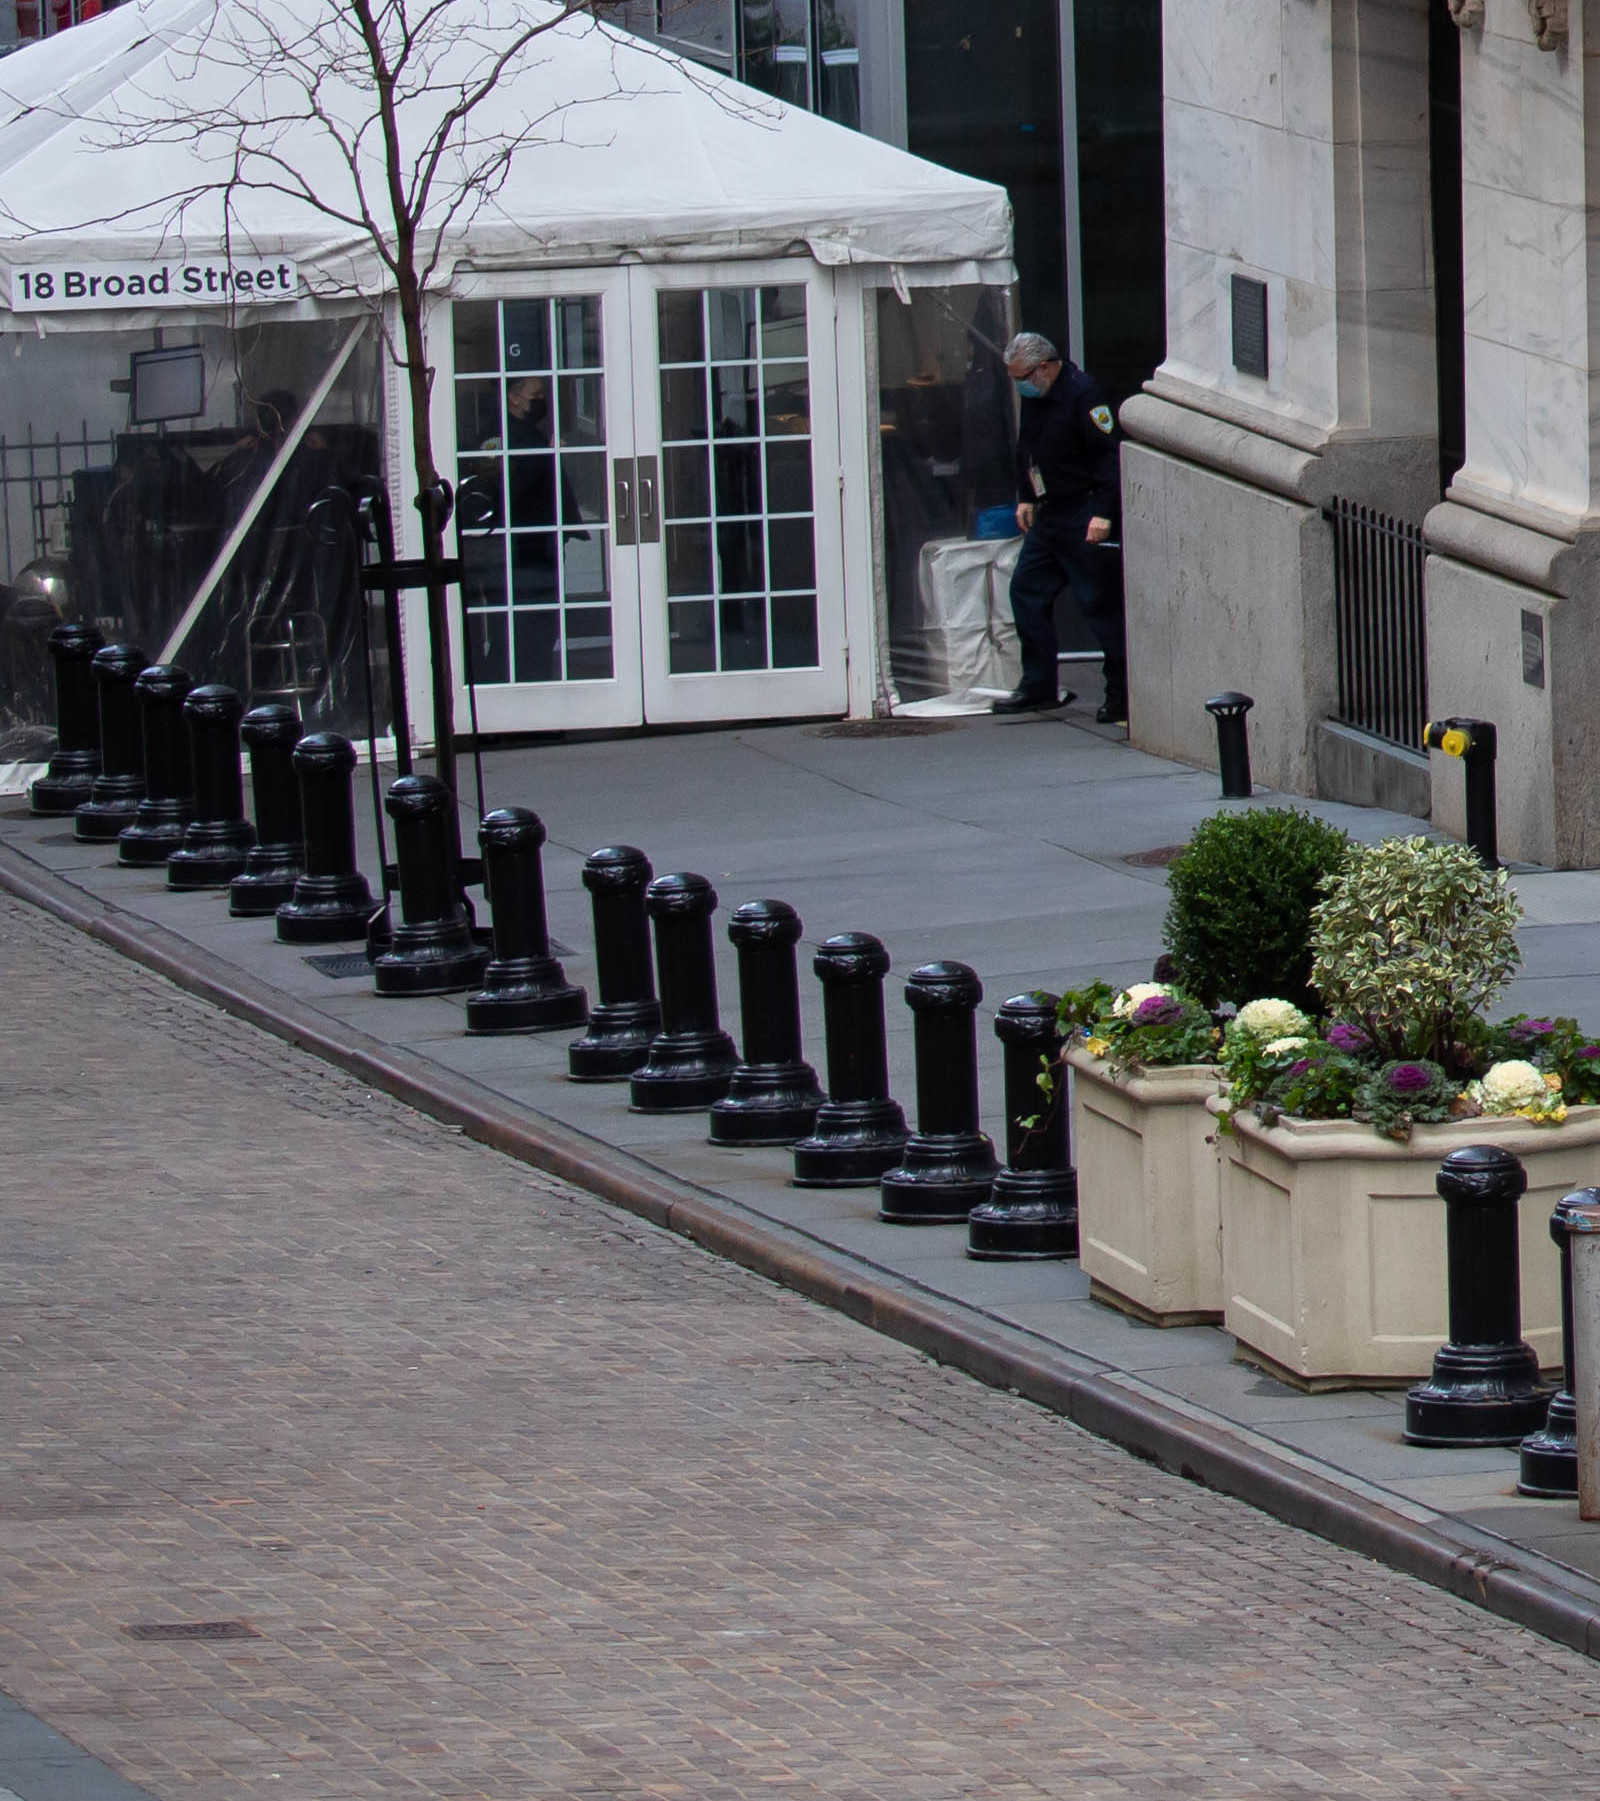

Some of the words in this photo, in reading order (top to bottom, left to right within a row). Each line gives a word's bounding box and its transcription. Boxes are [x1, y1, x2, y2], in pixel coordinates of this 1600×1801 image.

[18, 272, 55, 300] 18
[63, 266, 170, 299] Broad
[182, 263, 291, 294] Street
